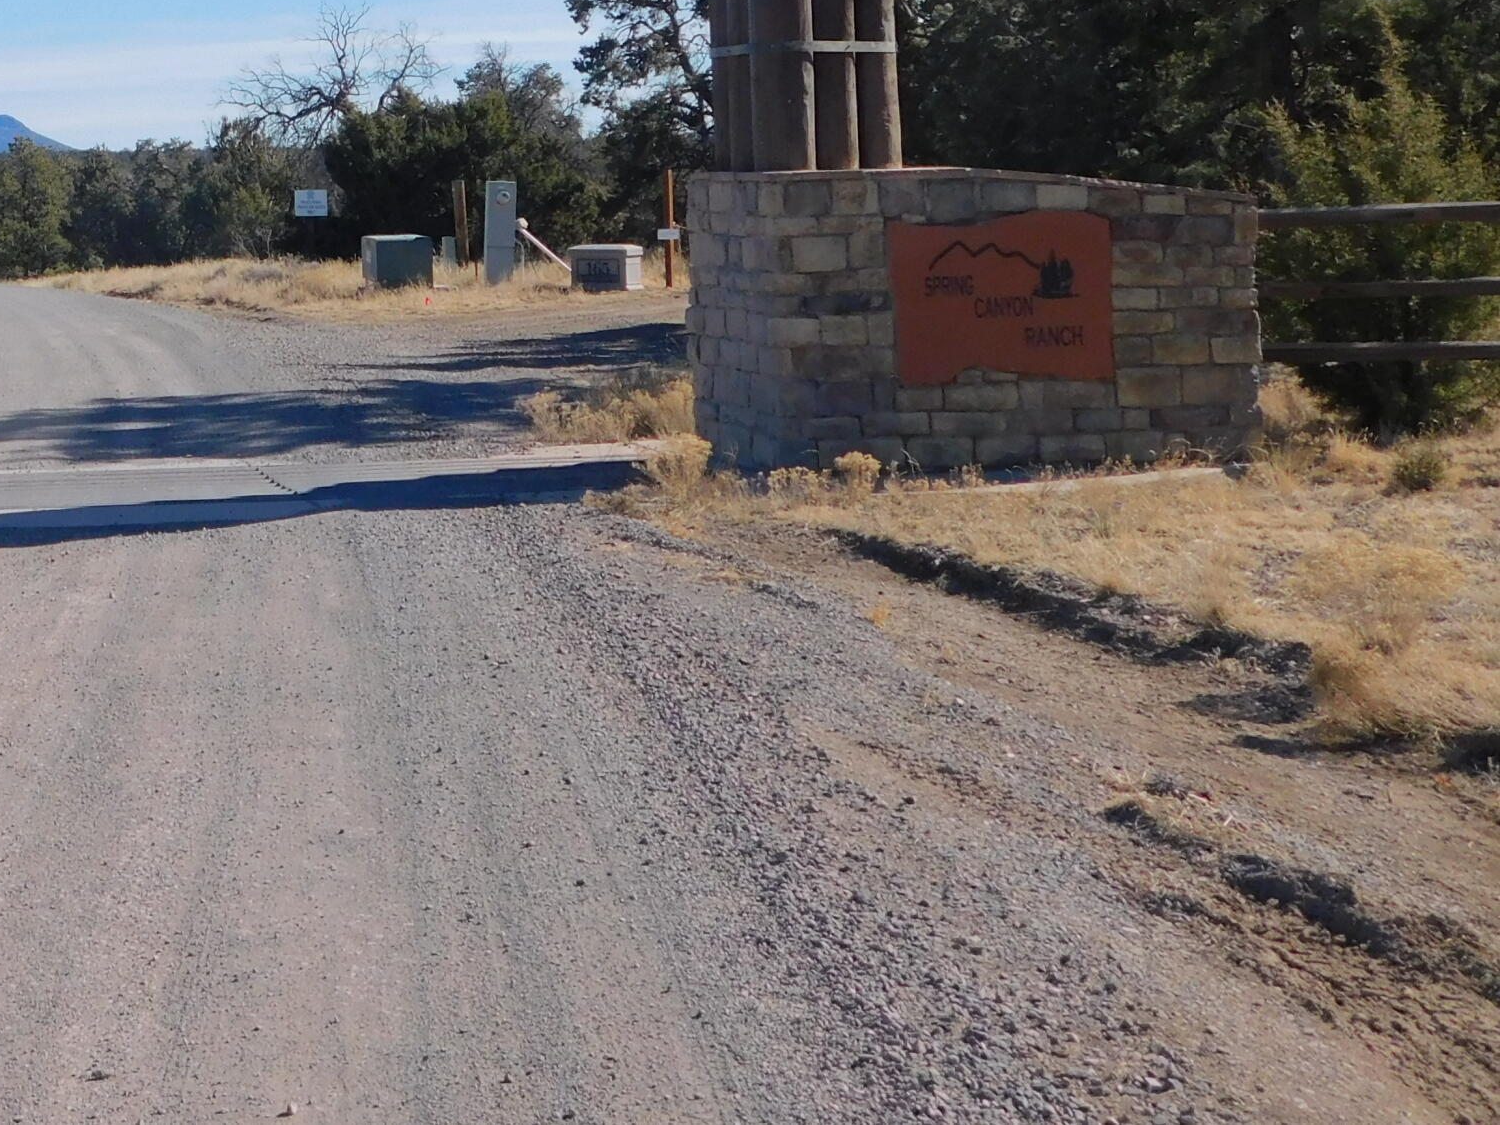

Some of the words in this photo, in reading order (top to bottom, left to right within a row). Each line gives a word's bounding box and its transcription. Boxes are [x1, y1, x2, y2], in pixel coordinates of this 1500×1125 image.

[924, 275, 974, 297] SPRING
[974, 296, 1033, 318] CANYON
[1024, 325, 1084, 347] RANCH
